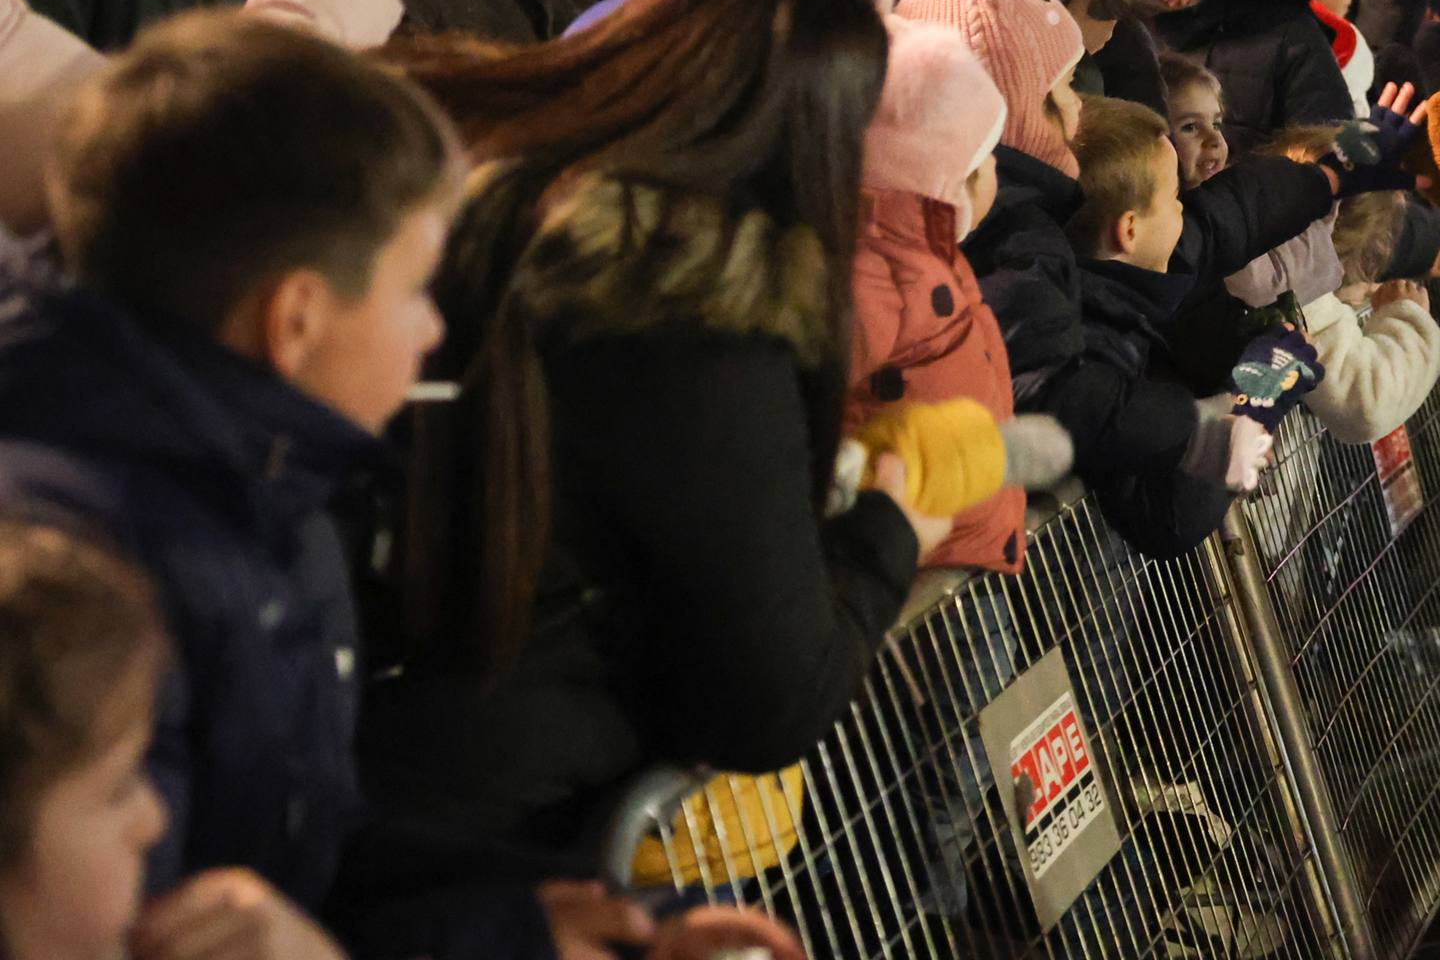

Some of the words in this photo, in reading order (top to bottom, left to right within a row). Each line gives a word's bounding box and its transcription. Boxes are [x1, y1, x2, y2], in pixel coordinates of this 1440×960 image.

[1029, 834, 1053, 871] 983
[1052, 817, 1069, 846] 36
[1068, 800, 1085, 829] 04
[1085, 783, 1102, 812] 32
